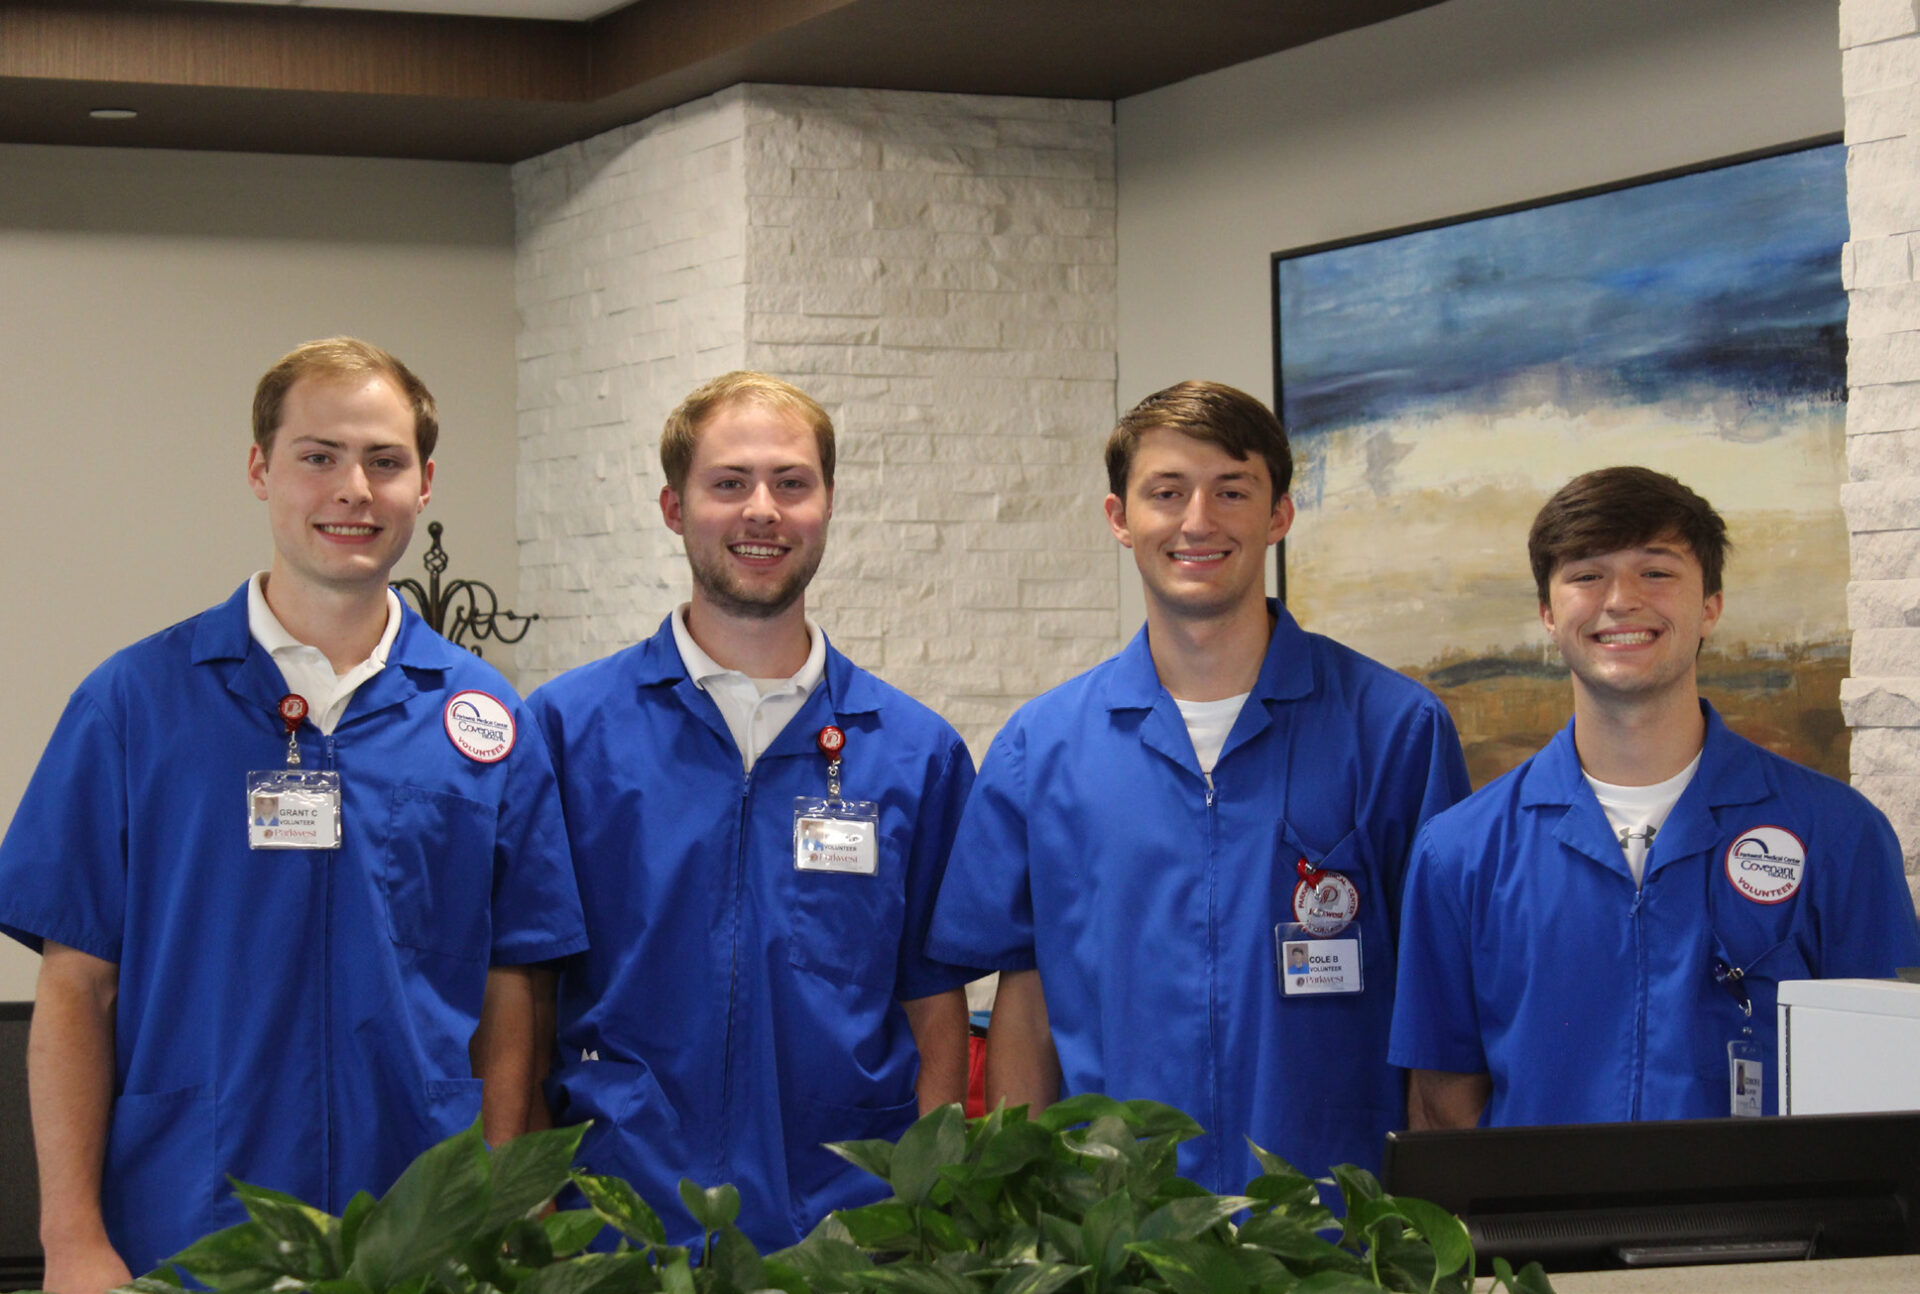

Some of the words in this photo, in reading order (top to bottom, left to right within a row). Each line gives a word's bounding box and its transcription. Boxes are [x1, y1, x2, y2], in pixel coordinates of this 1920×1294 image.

[458, 720, 505, 743] Covenant
[458, 736, 505, 757] VOLUNTEER
[279, 808, 309, 817] GRANT
[311, 809, 318, 817] C
[274, 828, 317, 838] Parkwest
[824, 844, 857, 852] VOLUNTEER
[1784, 856, 1801, 864] Center
[1740, 860, 1796, 881] Covenant
[1738, 876, 1793, 897] VOLUNTEER
[1309, 955, 1331, 964] COLE
[1333, 955, 1339, 963] B
[1310, 965, 1342, 973] VOLUNTEER
